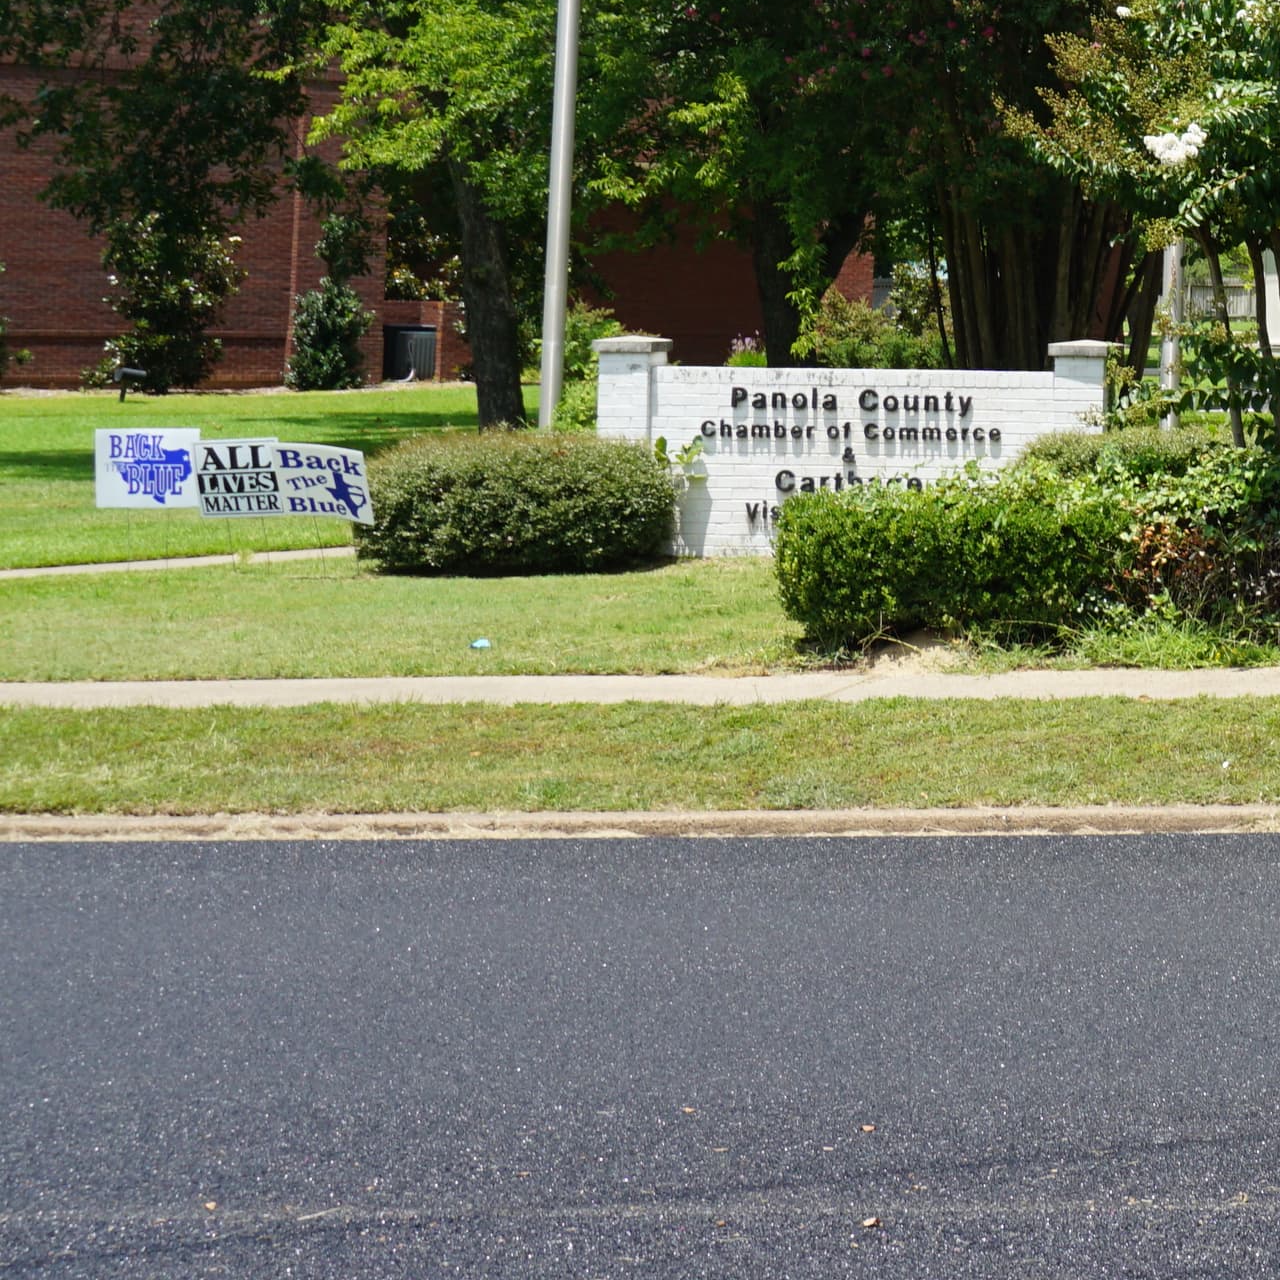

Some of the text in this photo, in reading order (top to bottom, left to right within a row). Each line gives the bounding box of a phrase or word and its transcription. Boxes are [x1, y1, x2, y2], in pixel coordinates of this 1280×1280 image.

[731, 387, 973, 417] Panola County
[701, 419, 1001, 442] Chamber of Commerce
[109, 434, 164, 458] BACK
[200, 445, 272, 470] ALL
[842, 447, 856, 463] &
[276, 450, 363, 477] Back
[127, 465, 183, 495] BLUE
[202, 472, 276, 494] LIVES
[286, 475, 328, 491] The
[204, 494, 280, 513] MATTER
[287, 496, 348, 515] Blue
